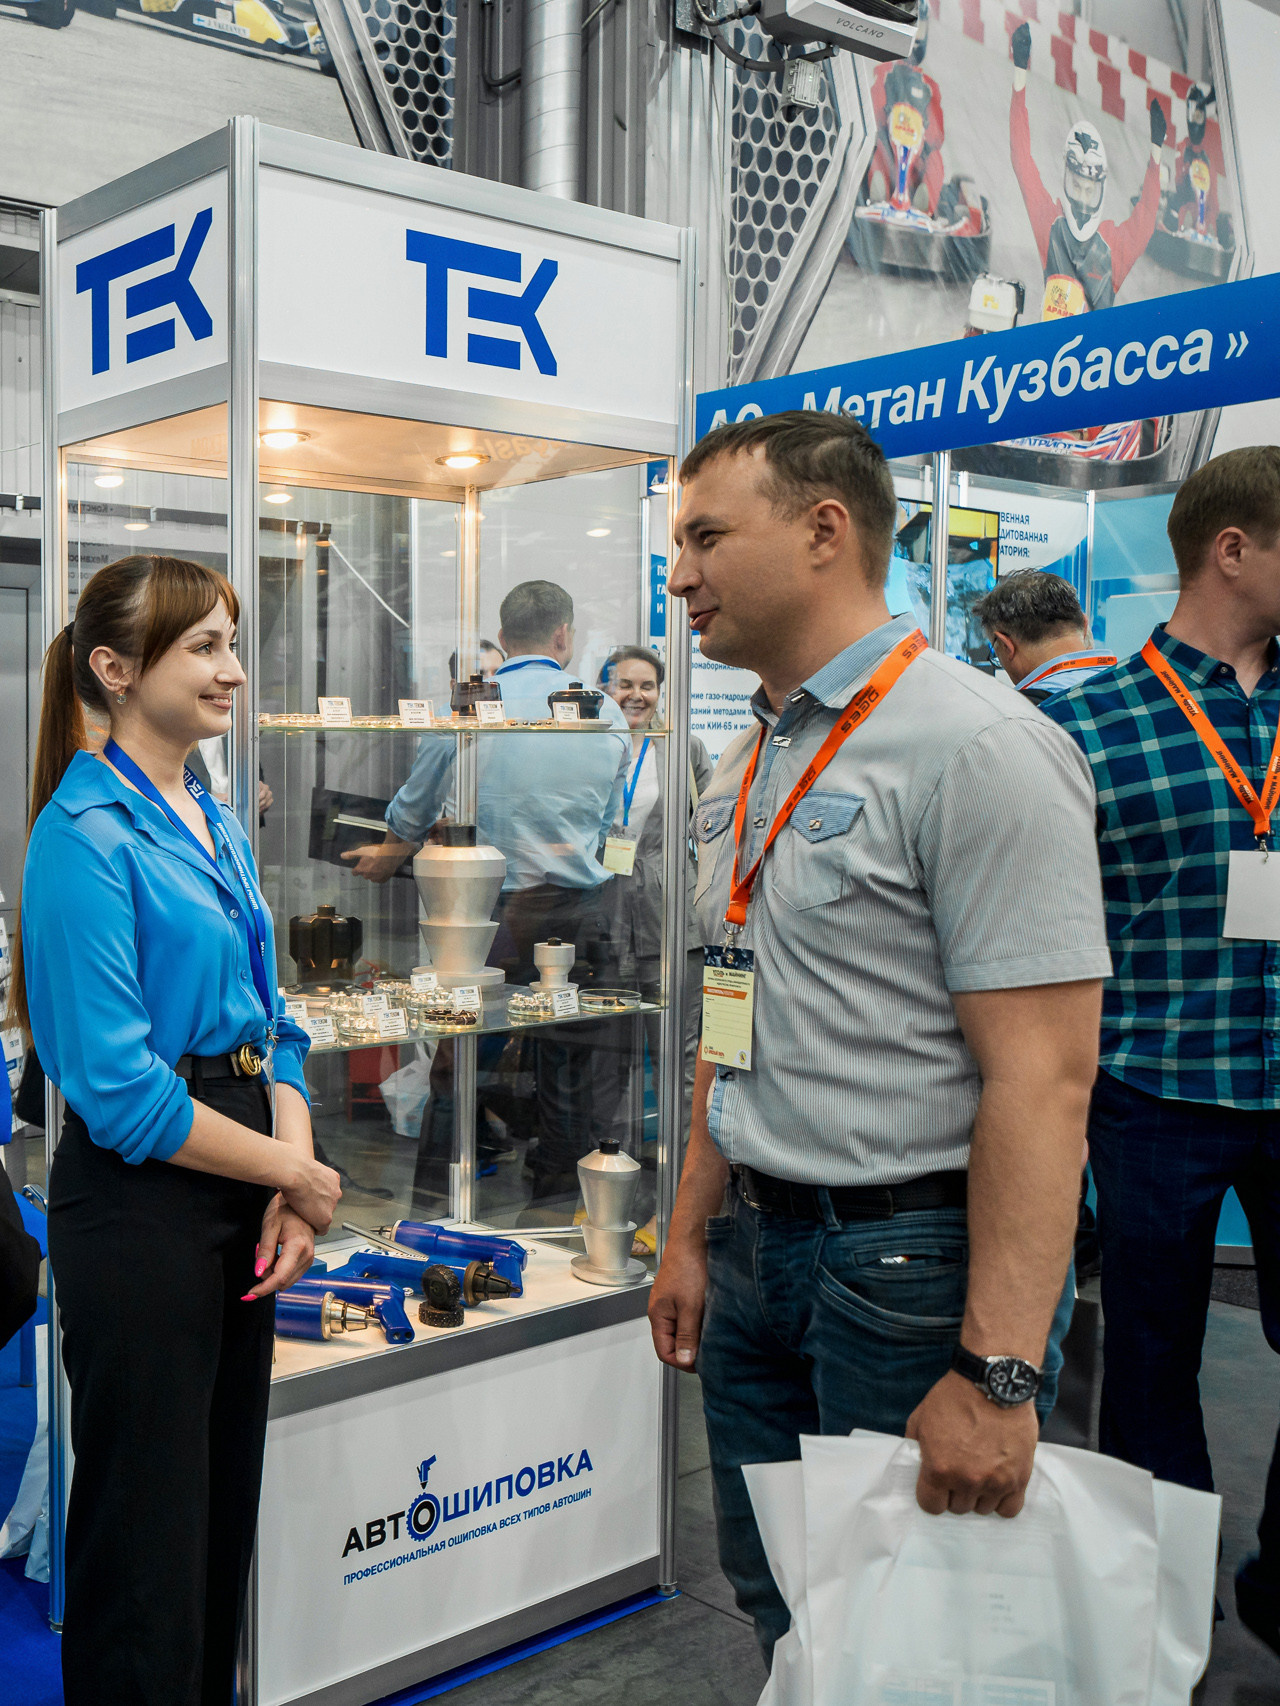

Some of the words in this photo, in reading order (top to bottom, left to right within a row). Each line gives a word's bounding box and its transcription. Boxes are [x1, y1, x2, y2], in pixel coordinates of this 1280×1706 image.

[836, 17, 884, 39] VOLCANO
[957, 329, 1213, 424] Кузбасса
[713, 707, 746, 715] методами
[342, 1449, 593, 1558] АВТОШИПОВКА
[343, 1540, 445, 1585] ПРОФЕССИОНАЛЬНАЯ
[448, 1522, 497, 1547] ОШИПОВКА
[499, 1514, 521, 1529] ВСЕХ
[523, 1503, 550, 1521] ТИПОВ
[552, 1488, 591, 1510] АВТОШИН
